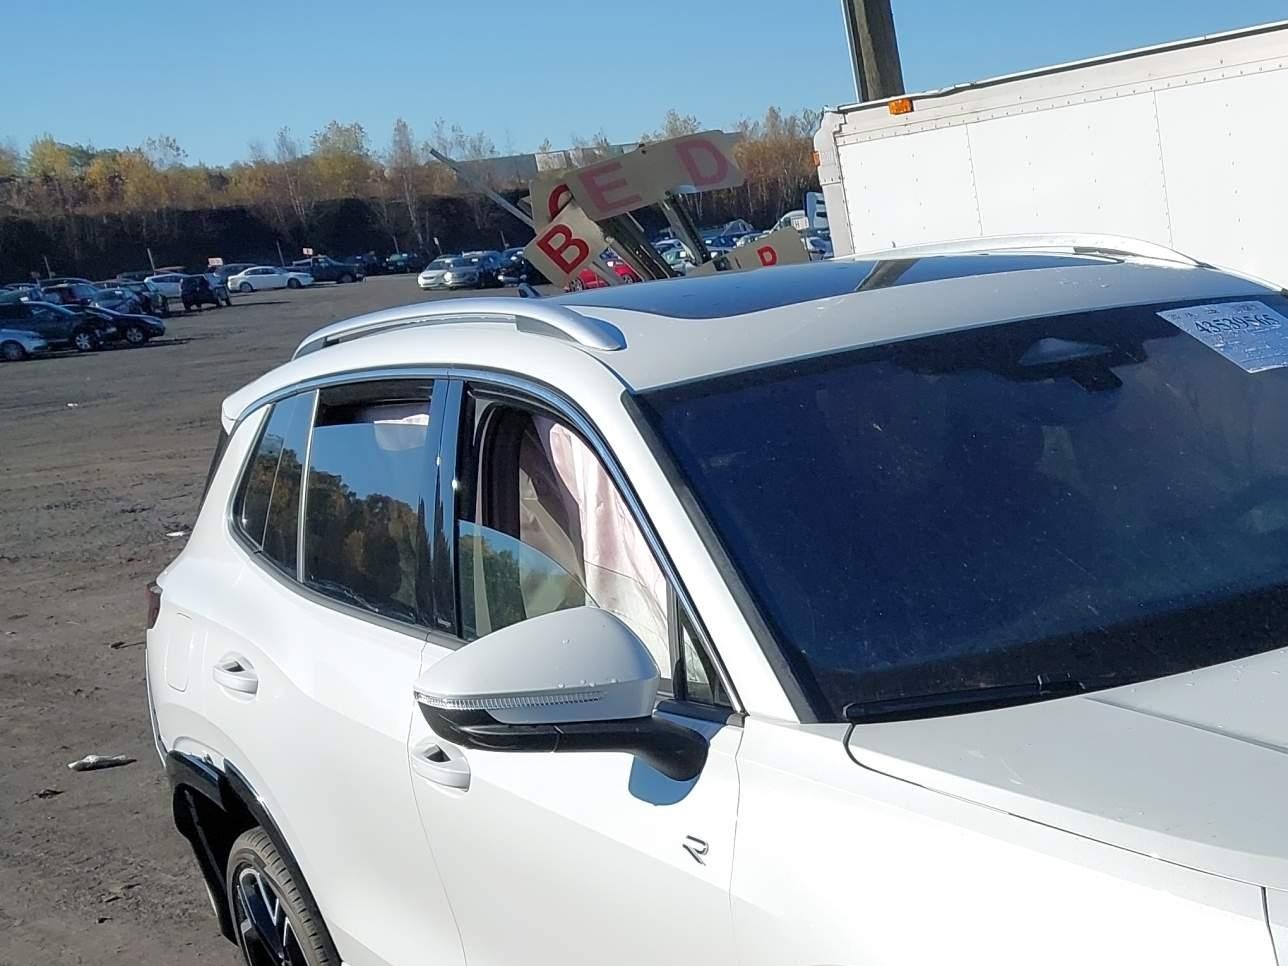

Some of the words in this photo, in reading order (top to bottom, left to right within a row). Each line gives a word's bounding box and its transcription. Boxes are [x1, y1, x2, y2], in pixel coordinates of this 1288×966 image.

[578, 161, 642, 211] E
[675, 138, 730, 188] D
[536, 224, 590, 275] B
[1194, 314, 1281, 334] 43539565
